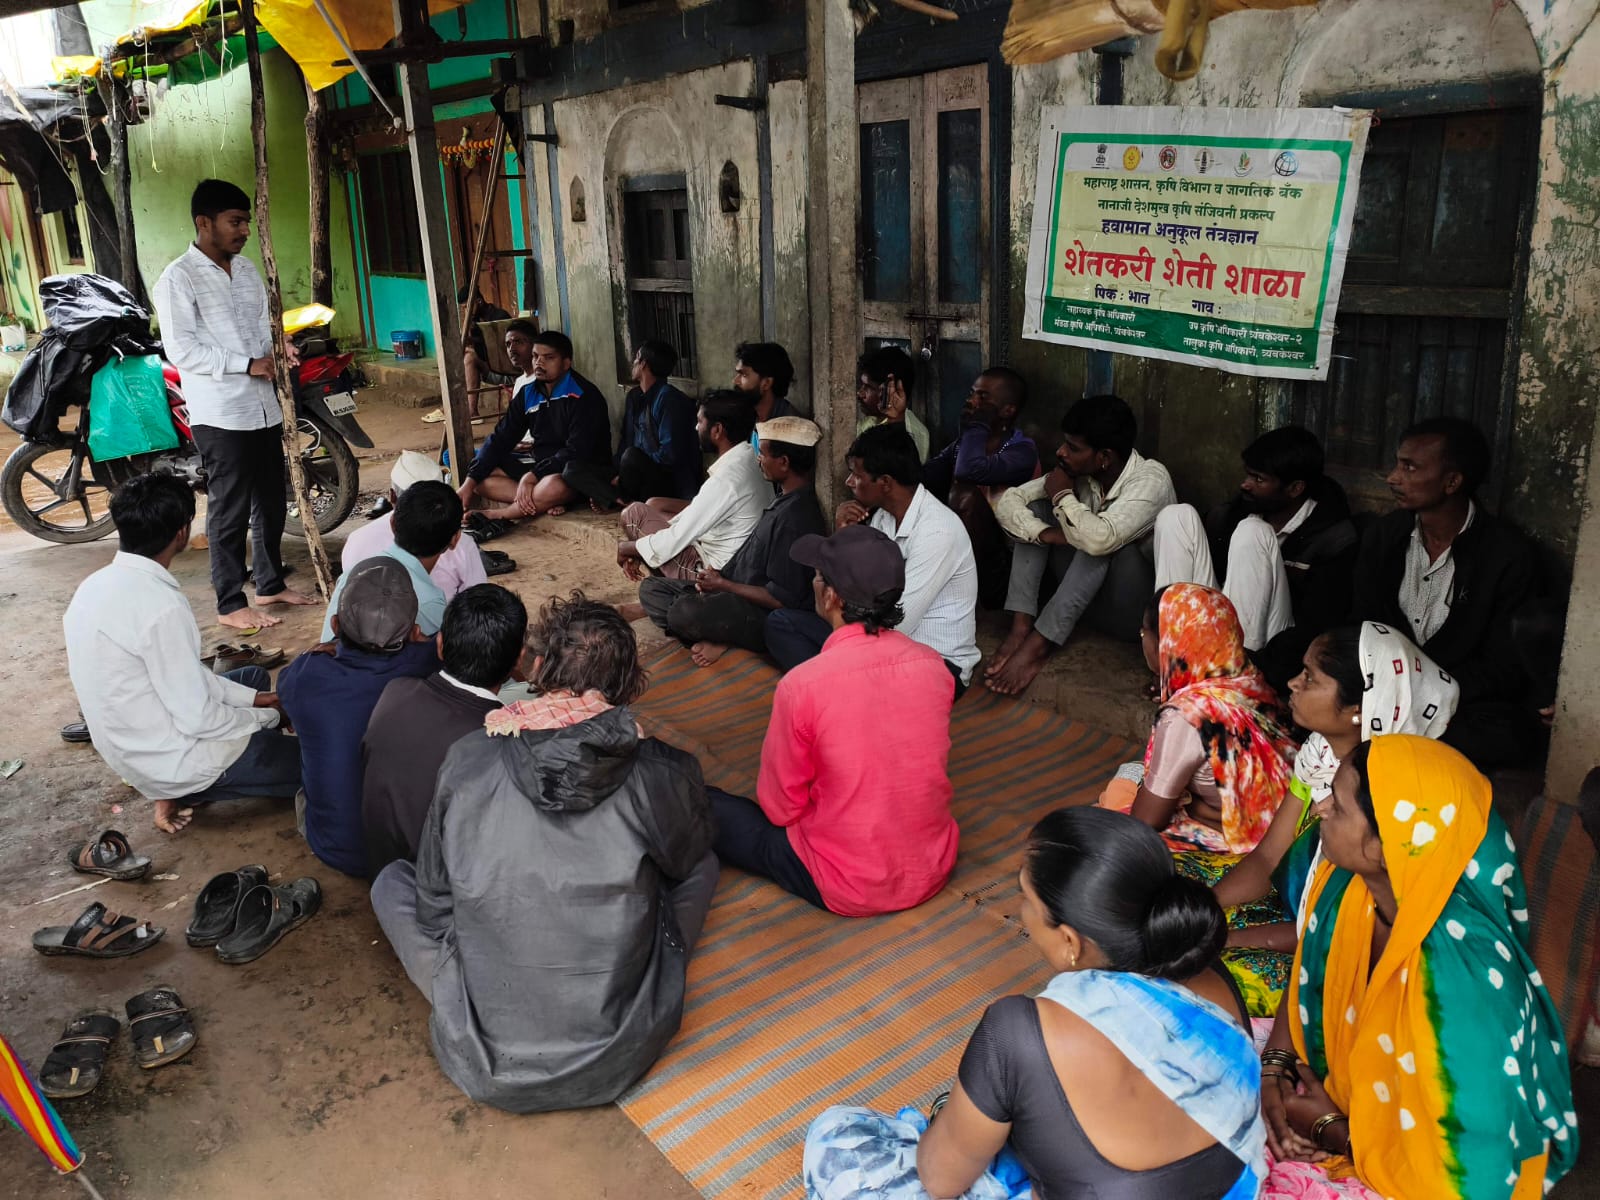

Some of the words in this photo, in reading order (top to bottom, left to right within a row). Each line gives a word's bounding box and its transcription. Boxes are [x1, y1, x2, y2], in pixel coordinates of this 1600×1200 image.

[1083, 177, 1118, 192] महाराष्ट्र
[1156, 177, 1177, 195] कृषि
[1179, 178, 1212, 194] विभाग
[1214, 183, 1223, 194] व
[1226, 182, 1275, 197] जागतिक
[1097, 198, 1132, 211] नानाजी
[1134, 198, 1170, 217] देशमुख
[1172, 201, 1192, 218] कृषि
[1240, 208, 1276, 221] प्रकल्प
[1101, 219, 1151, 235] हवामान
[1154, 221, 1202, 245] अनुकूल
[1205, 222, 1259, 245] तंत्रज्ञान
[1064, 239, 1156, 282] शेतकरी
[1163, 248, 1217, 290] शेती
[1224, 263, 1306, 299] शाळा
[1094, 283, 1118, 300] पिक
[1128, 290, 1150, 304] भात
[1107, 309, 1136, 321] अधिकारी
[1191, 299, 1215, 314] गाव
[1183, 337, 1207, 350] तालुका
[1208, 339, 1224, 353] कृषि
